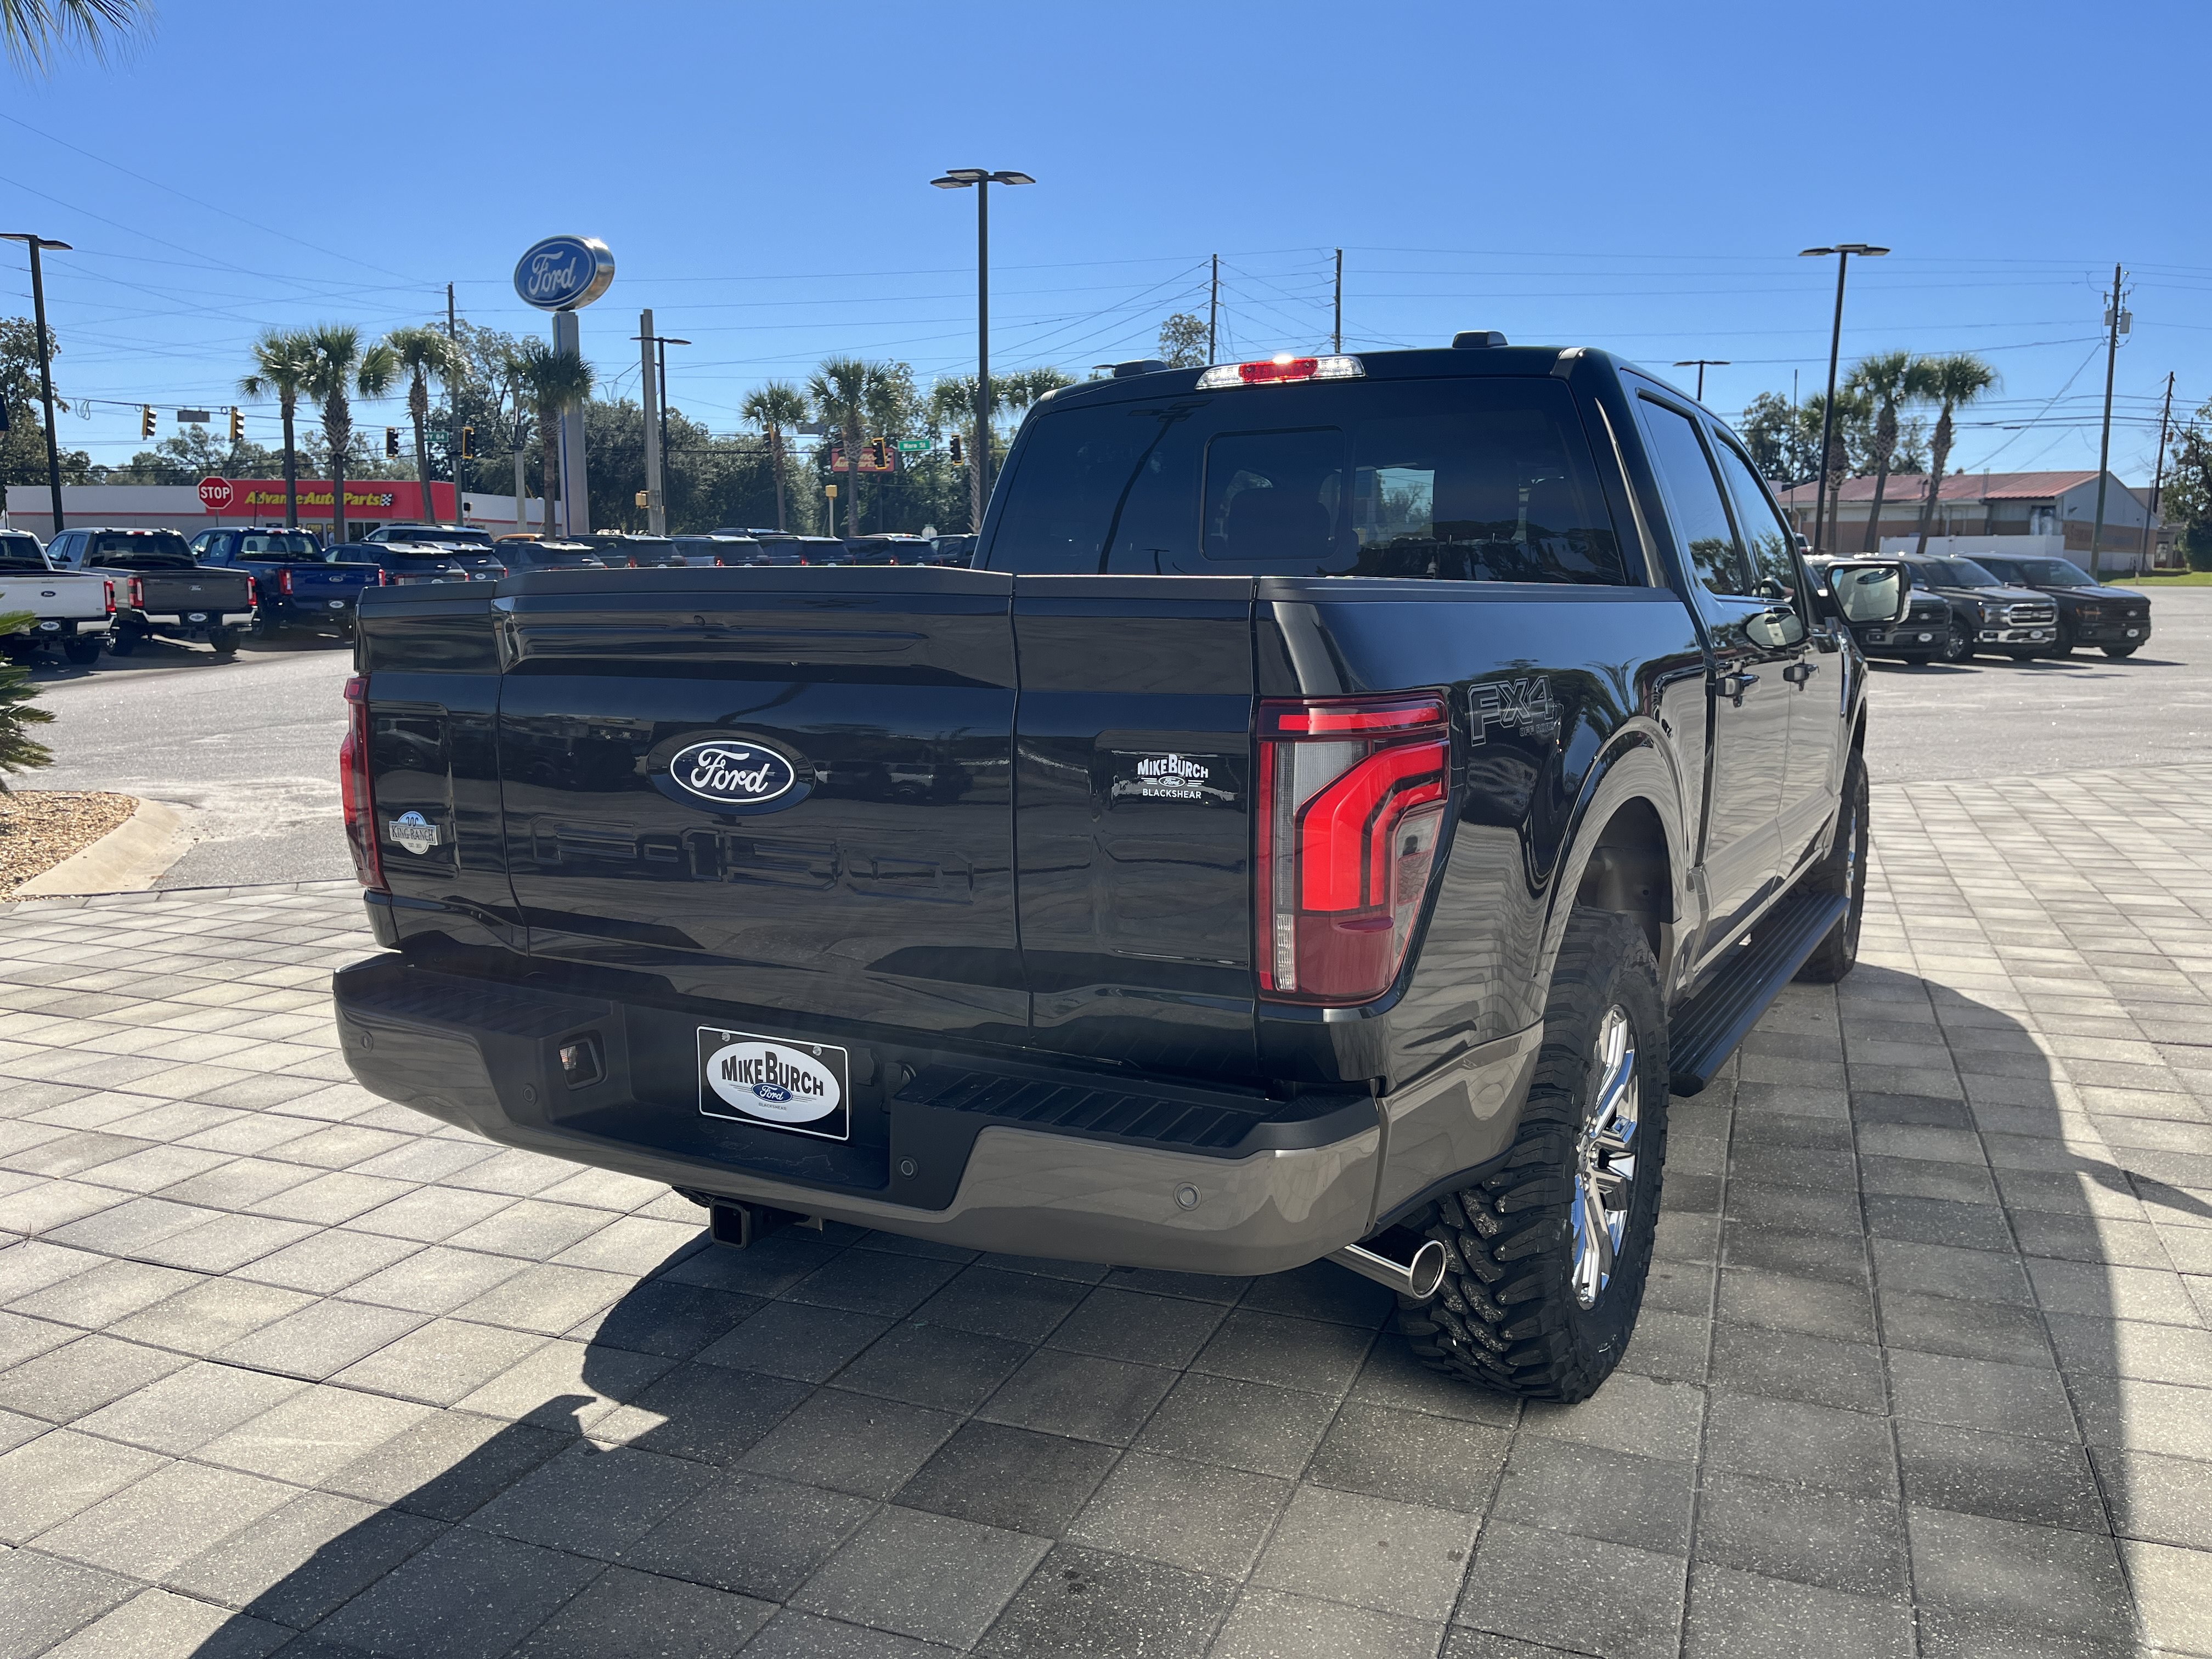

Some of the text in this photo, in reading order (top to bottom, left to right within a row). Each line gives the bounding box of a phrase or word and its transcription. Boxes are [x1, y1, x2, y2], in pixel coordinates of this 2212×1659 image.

[528, 251, 577, 295] Ford
[200, 486, 230, 499] STOP
[245, 491, 303, 504] Advane
[343, 493, 379, 505] Parts
[1467, 675, 1554, 747] FX4
[1519, 725, 1534, 736] OFF
[690, 748, 770, 793] Ford
[1137, 754, 1209, 778] MIKE BURCH
[1163, 777, 1180, 786] Ford
[1142, 788, 1201, 799] BLACKSHEAR
[392, 825, 434, 841] KING RANCH
[721, 1051, 823, 1096] MIKE BURCH
[759, 1085, 784, 1101] Ford
[758, 1102, 787, 1110] BLACKSHEAR
